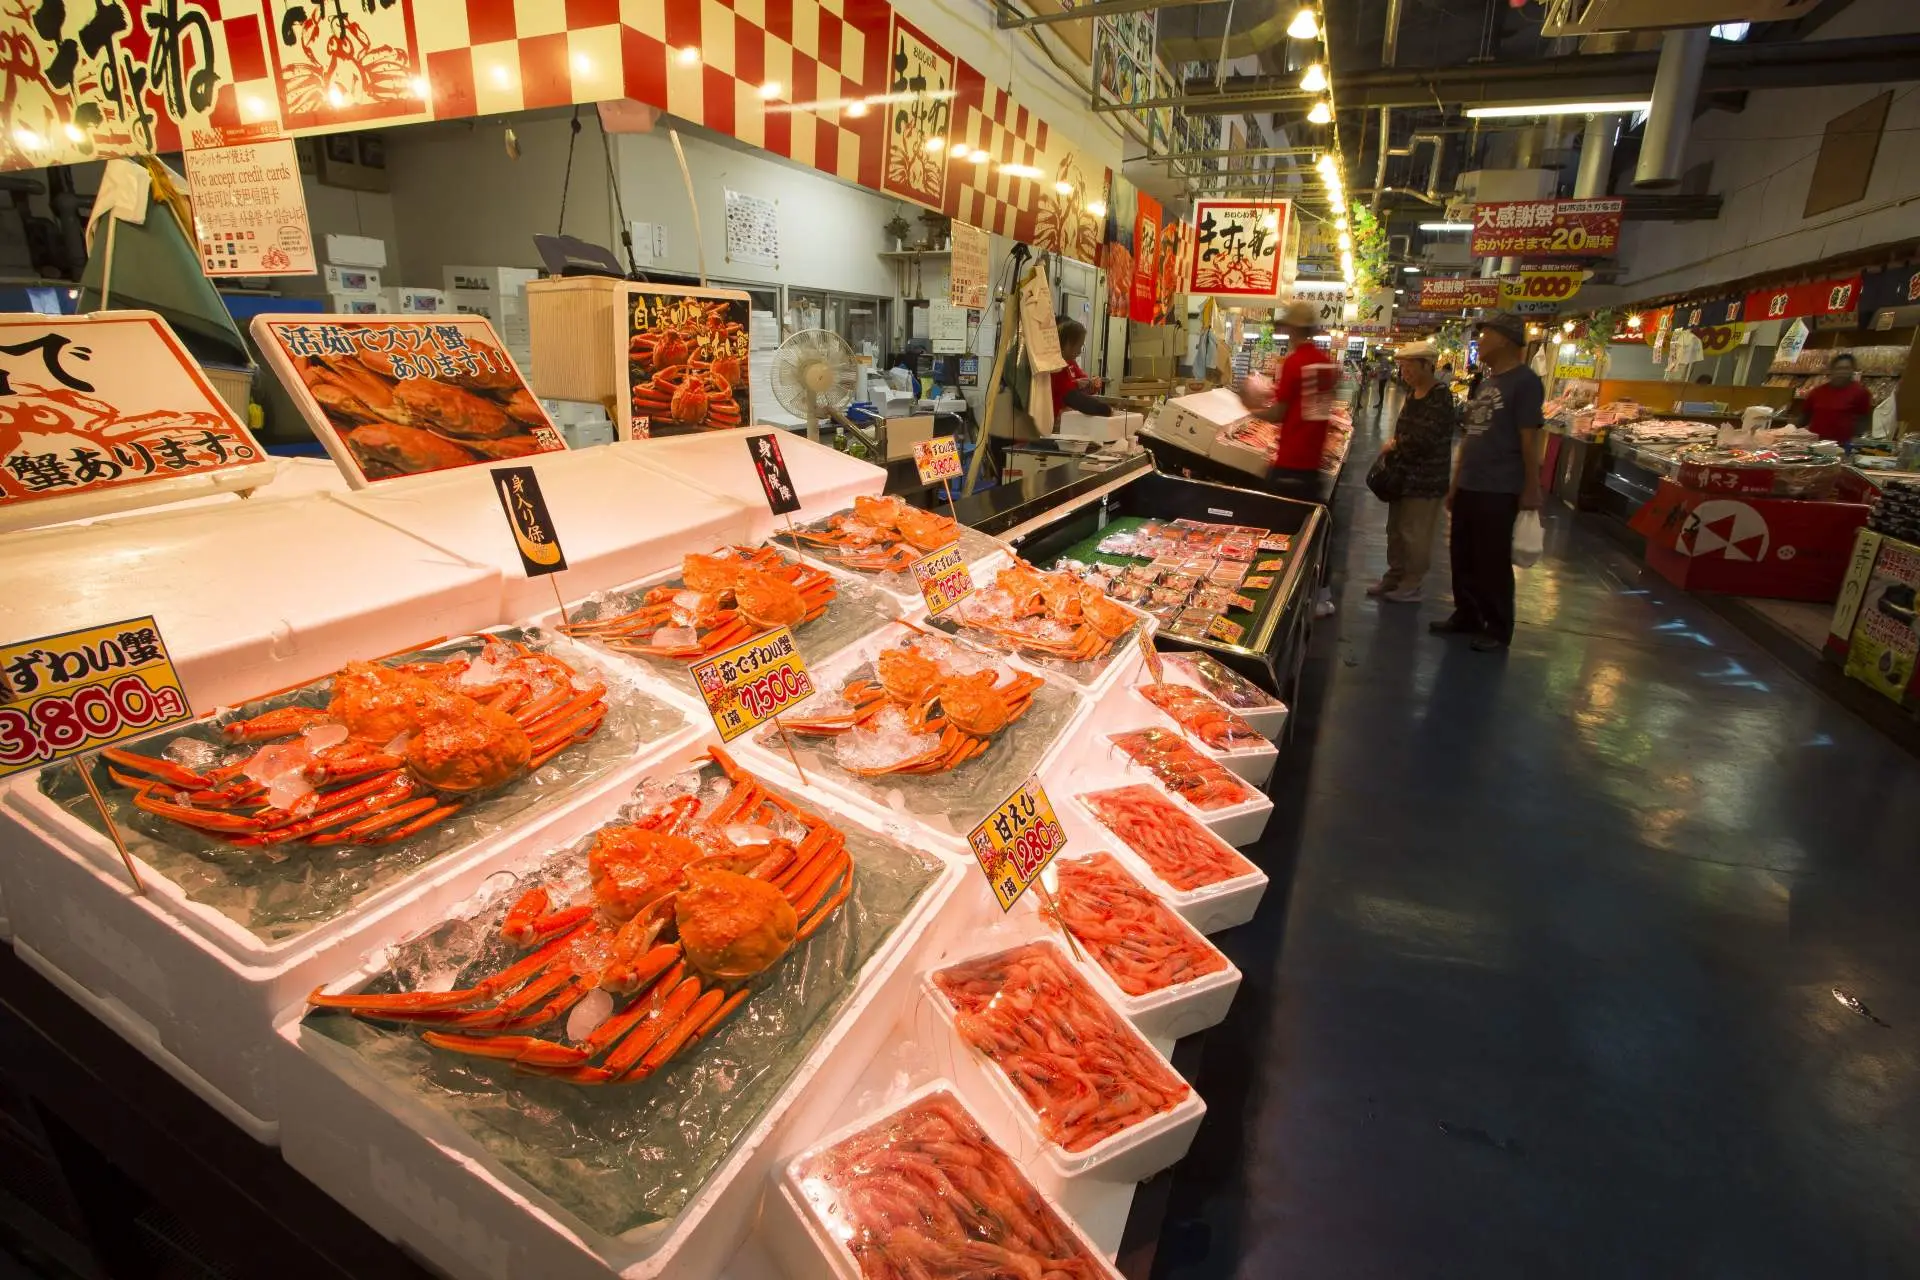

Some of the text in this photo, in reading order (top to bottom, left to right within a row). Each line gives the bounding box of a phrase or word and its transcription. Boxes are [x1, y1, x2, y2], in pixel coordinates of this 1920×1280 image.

[192, 162, 291, 188] We accept credit cards
[1474, 227, 1615, 251] おかげさまで20周年
[1476, 204, 1555, 228] 大感謝祭
[1423, 281, 1464, 293] 大感謝祭
[280, 324, 471, 356] 活茹でズワイ蟹
[0, 431, 254, 498] 蟹あります。
[4, 628, 165, 694] ずわい蟹
[719, 634, 795, 684] 茹でずわい蟹
[738, 664, 812, 720] 7,500円
[0, 674, 187, 766] 3,800円
[993, 790, 1036, 843] 甘えび
[1006, 815, 1063, 883] 1,280円
